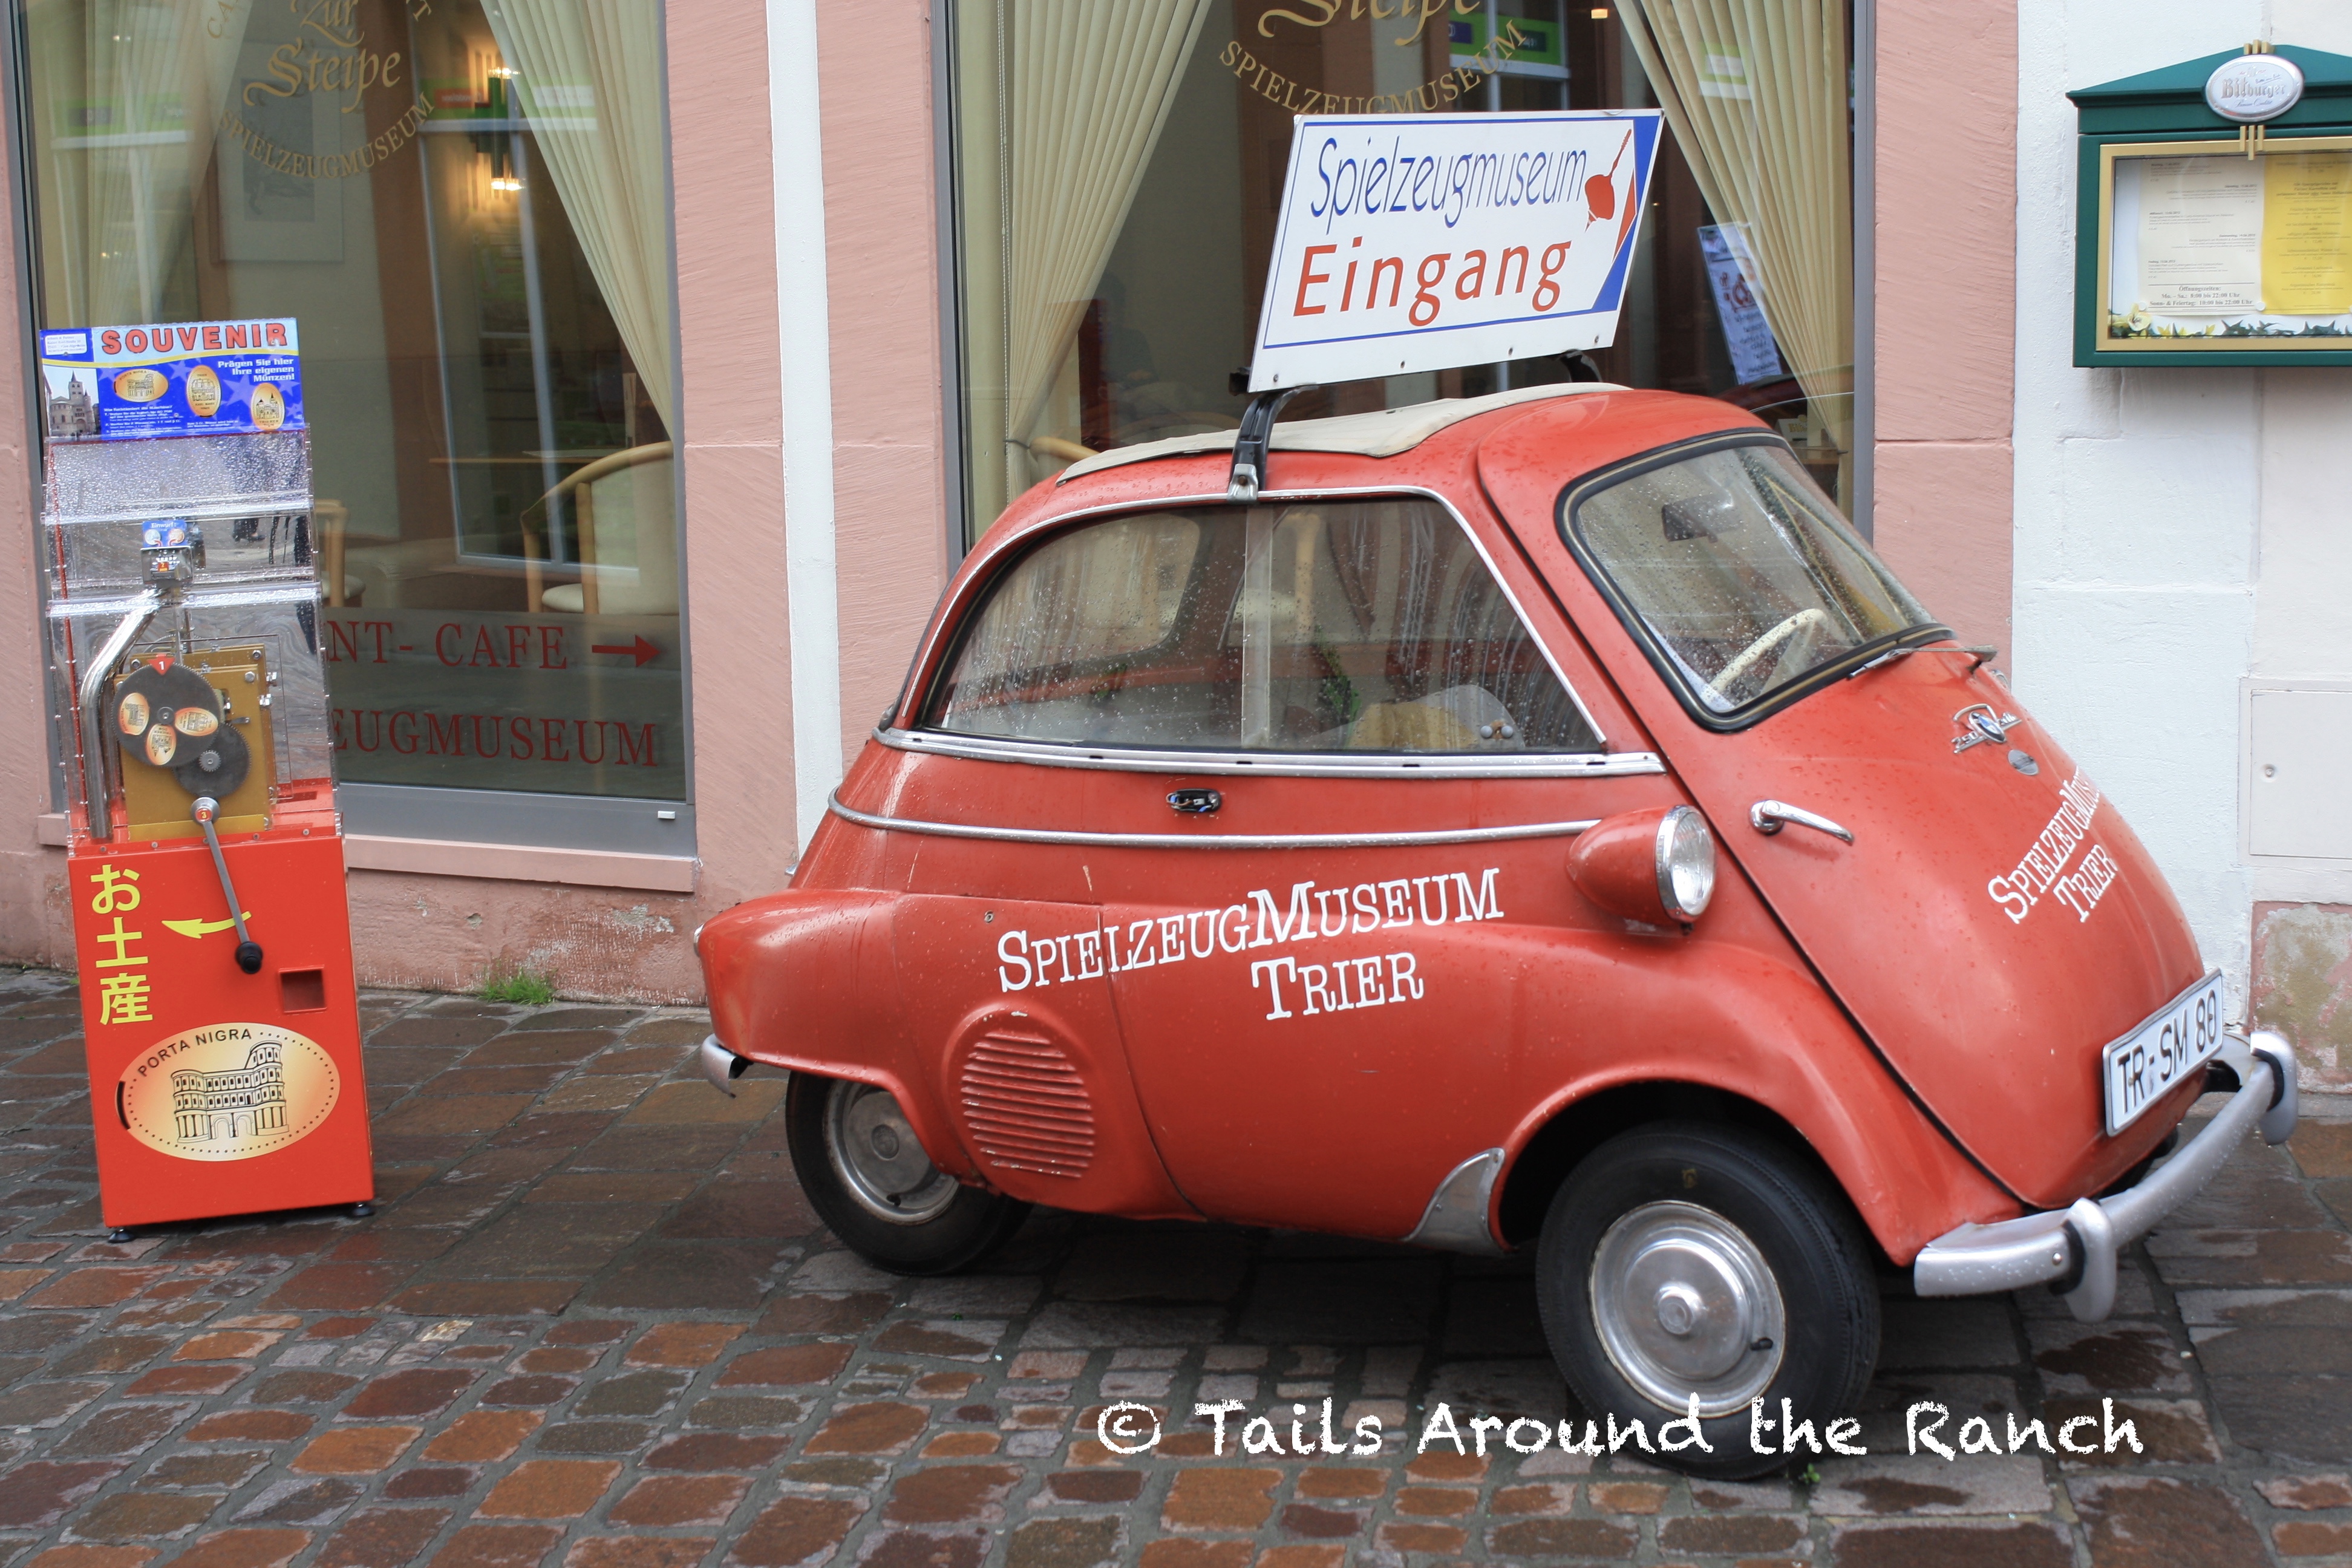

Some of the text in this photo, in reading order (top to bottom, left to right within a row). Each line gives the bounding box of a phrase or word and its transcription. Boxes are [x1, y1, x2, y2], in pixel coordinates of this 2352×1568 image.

[243, 28, 400, 114] Steipe
[1219, 19, 1527, 115] SPIELZEUGMUSEUM
[2221, 77, 2286, 99] Bitburger
[219, 91, 435, 180] SPIELZEUGMUSEUM
[1310, 136, 1587, 235] Spielzeugmuseum
[1293, 236, 1572, 327] Eingang
[101, 322, 287, 354] SOUVENIR
[218, 360, 253, 368] Prägen
[255, 367, 295, 375] eigenen
[253, 374, 295, 382] Münzen!
[158, 661, 165, 670] 1
[434, 622, 567, 670] CAFE
[2053, 844, 2118, 923] TRIER
[90, 864, 154, 1026] お土産
[997, 867, 1504, 993] SPIELZEUGMUSEUM
[1250, 951, 1425, 1021] TRIER
[137, 1028, 253, 1079] PORTA NIGRA
[2195, 988, 2216, 1053] 80
